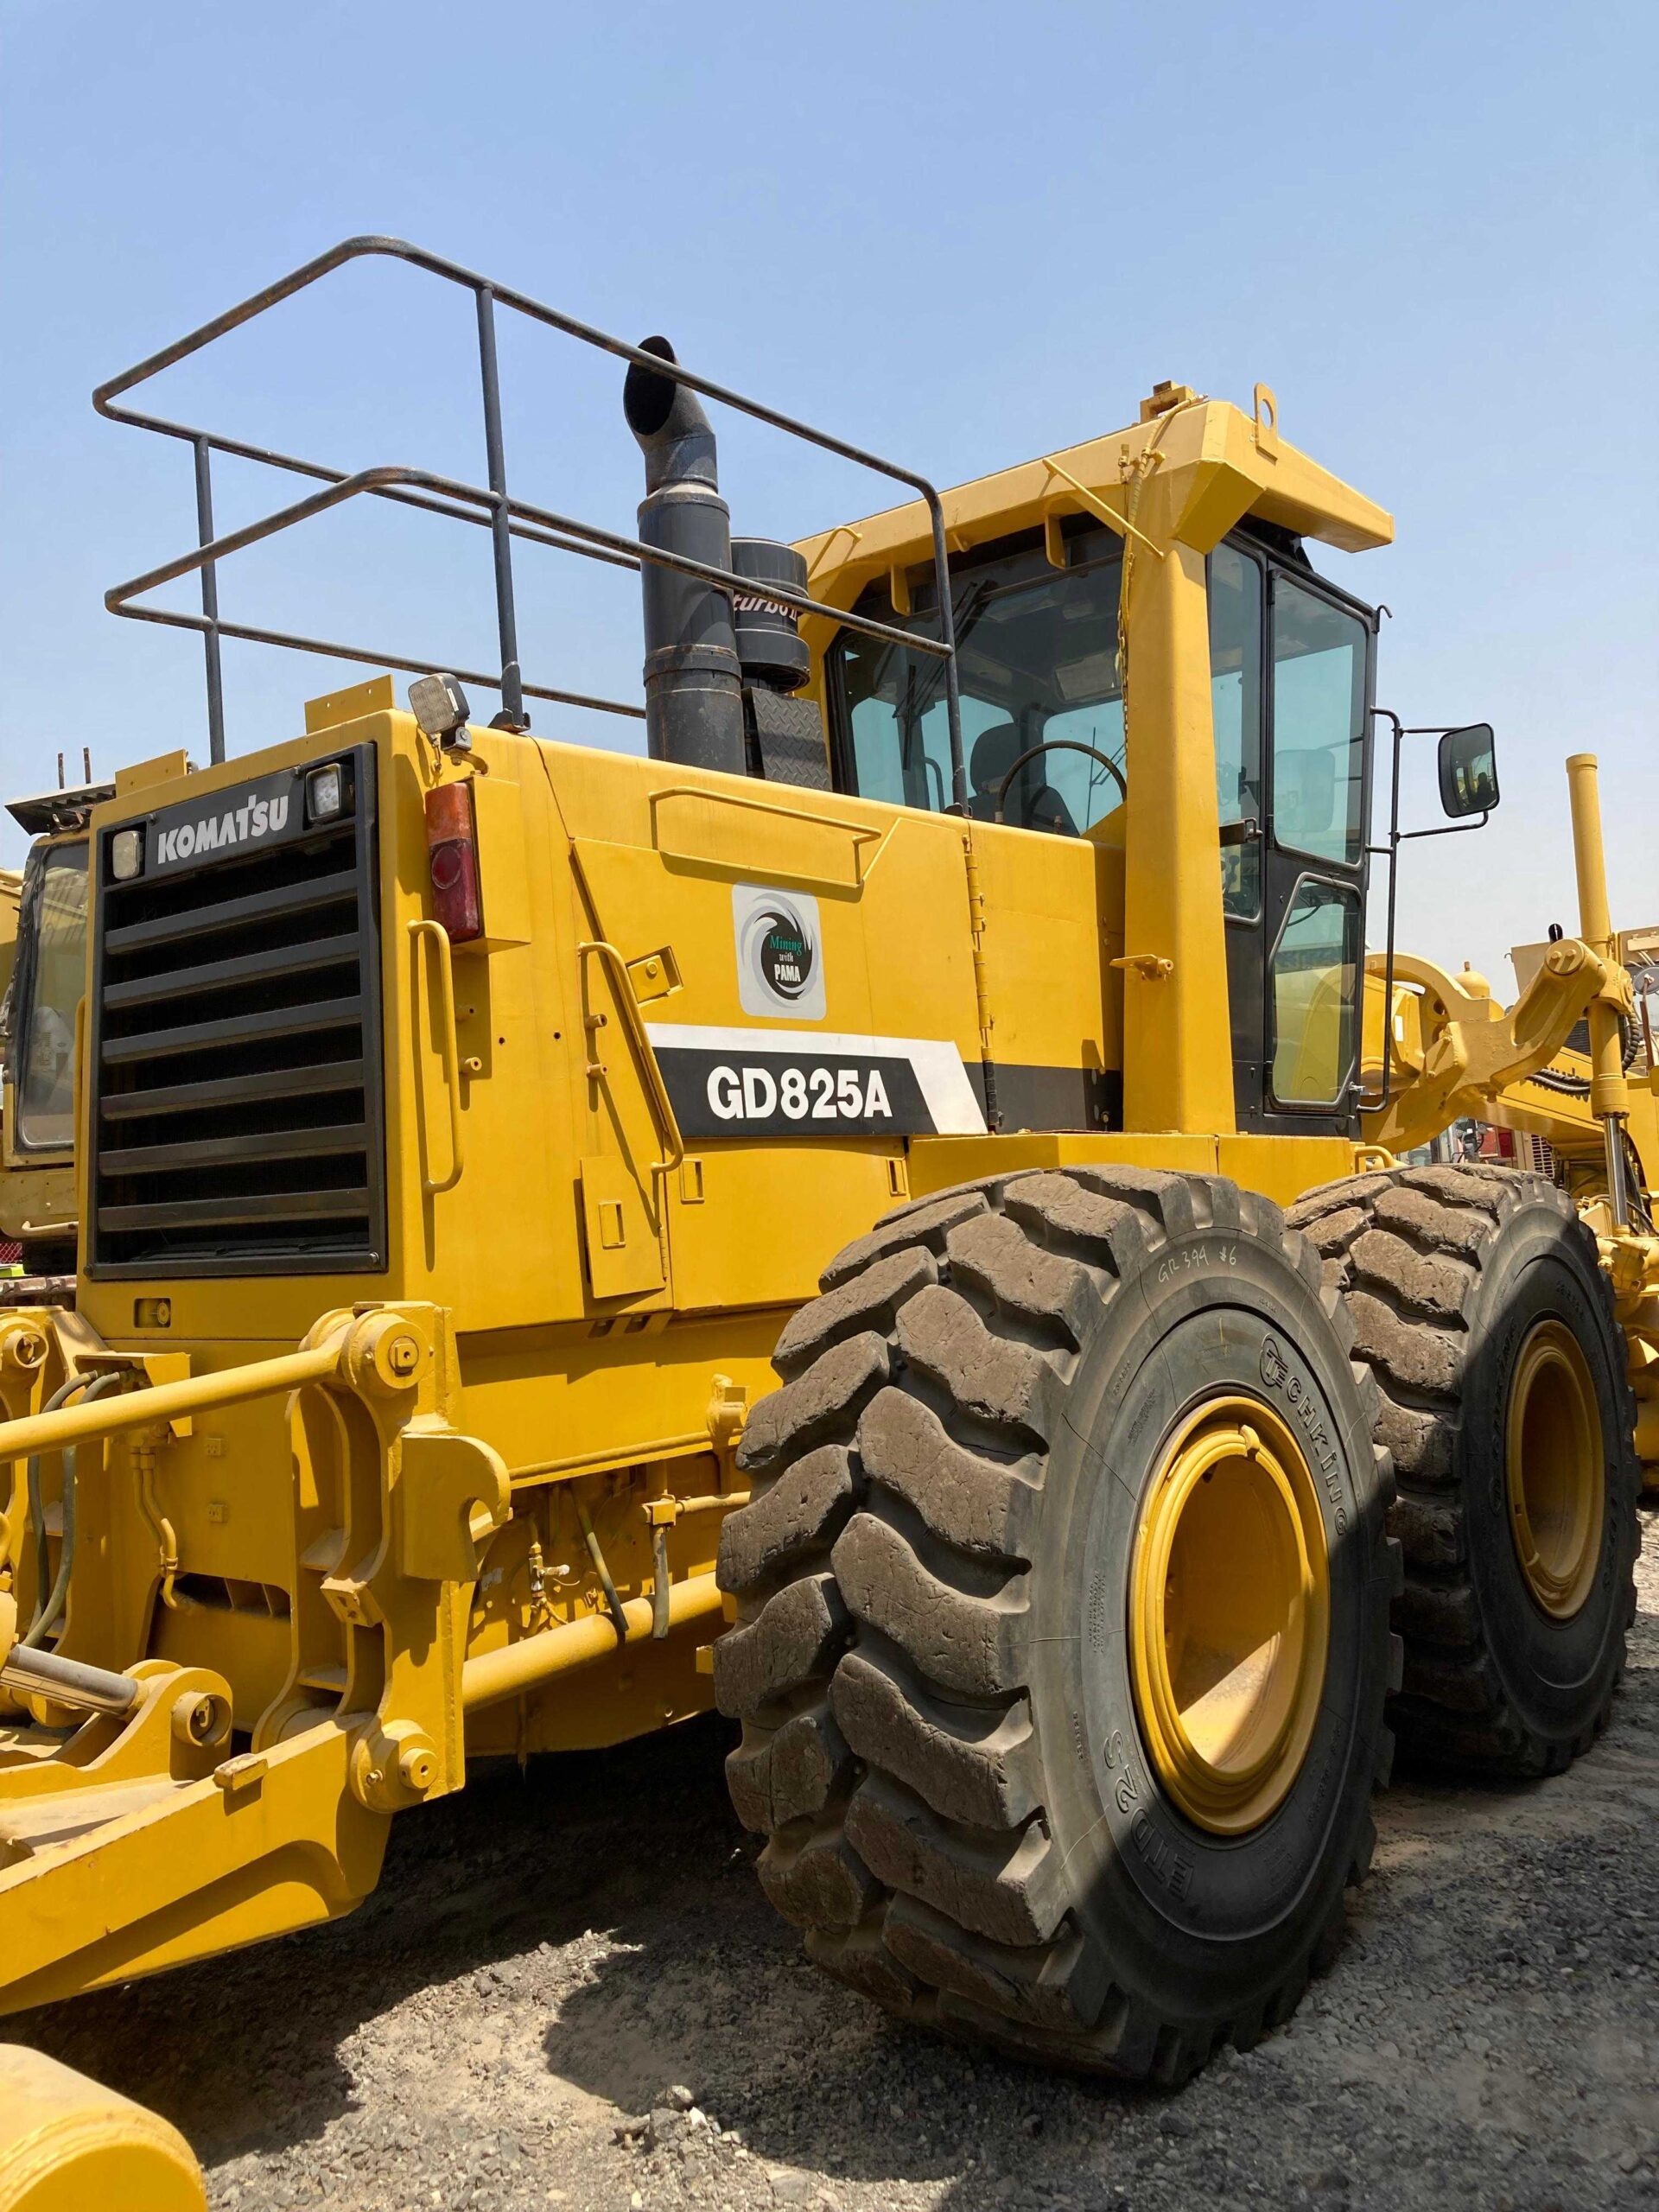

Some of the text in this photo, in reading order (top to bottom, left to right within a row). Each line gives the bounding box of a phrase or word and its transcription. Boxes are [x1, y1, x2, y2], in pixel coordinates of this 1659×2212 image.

[157, 794, 289, 865] KOMATSU
[769, 934, 802, 956] Mining
[779, 951, 794, 963] with
[774, 963, 801, 982] PAMA
[707, 1065, 893, 1120] GD825A
